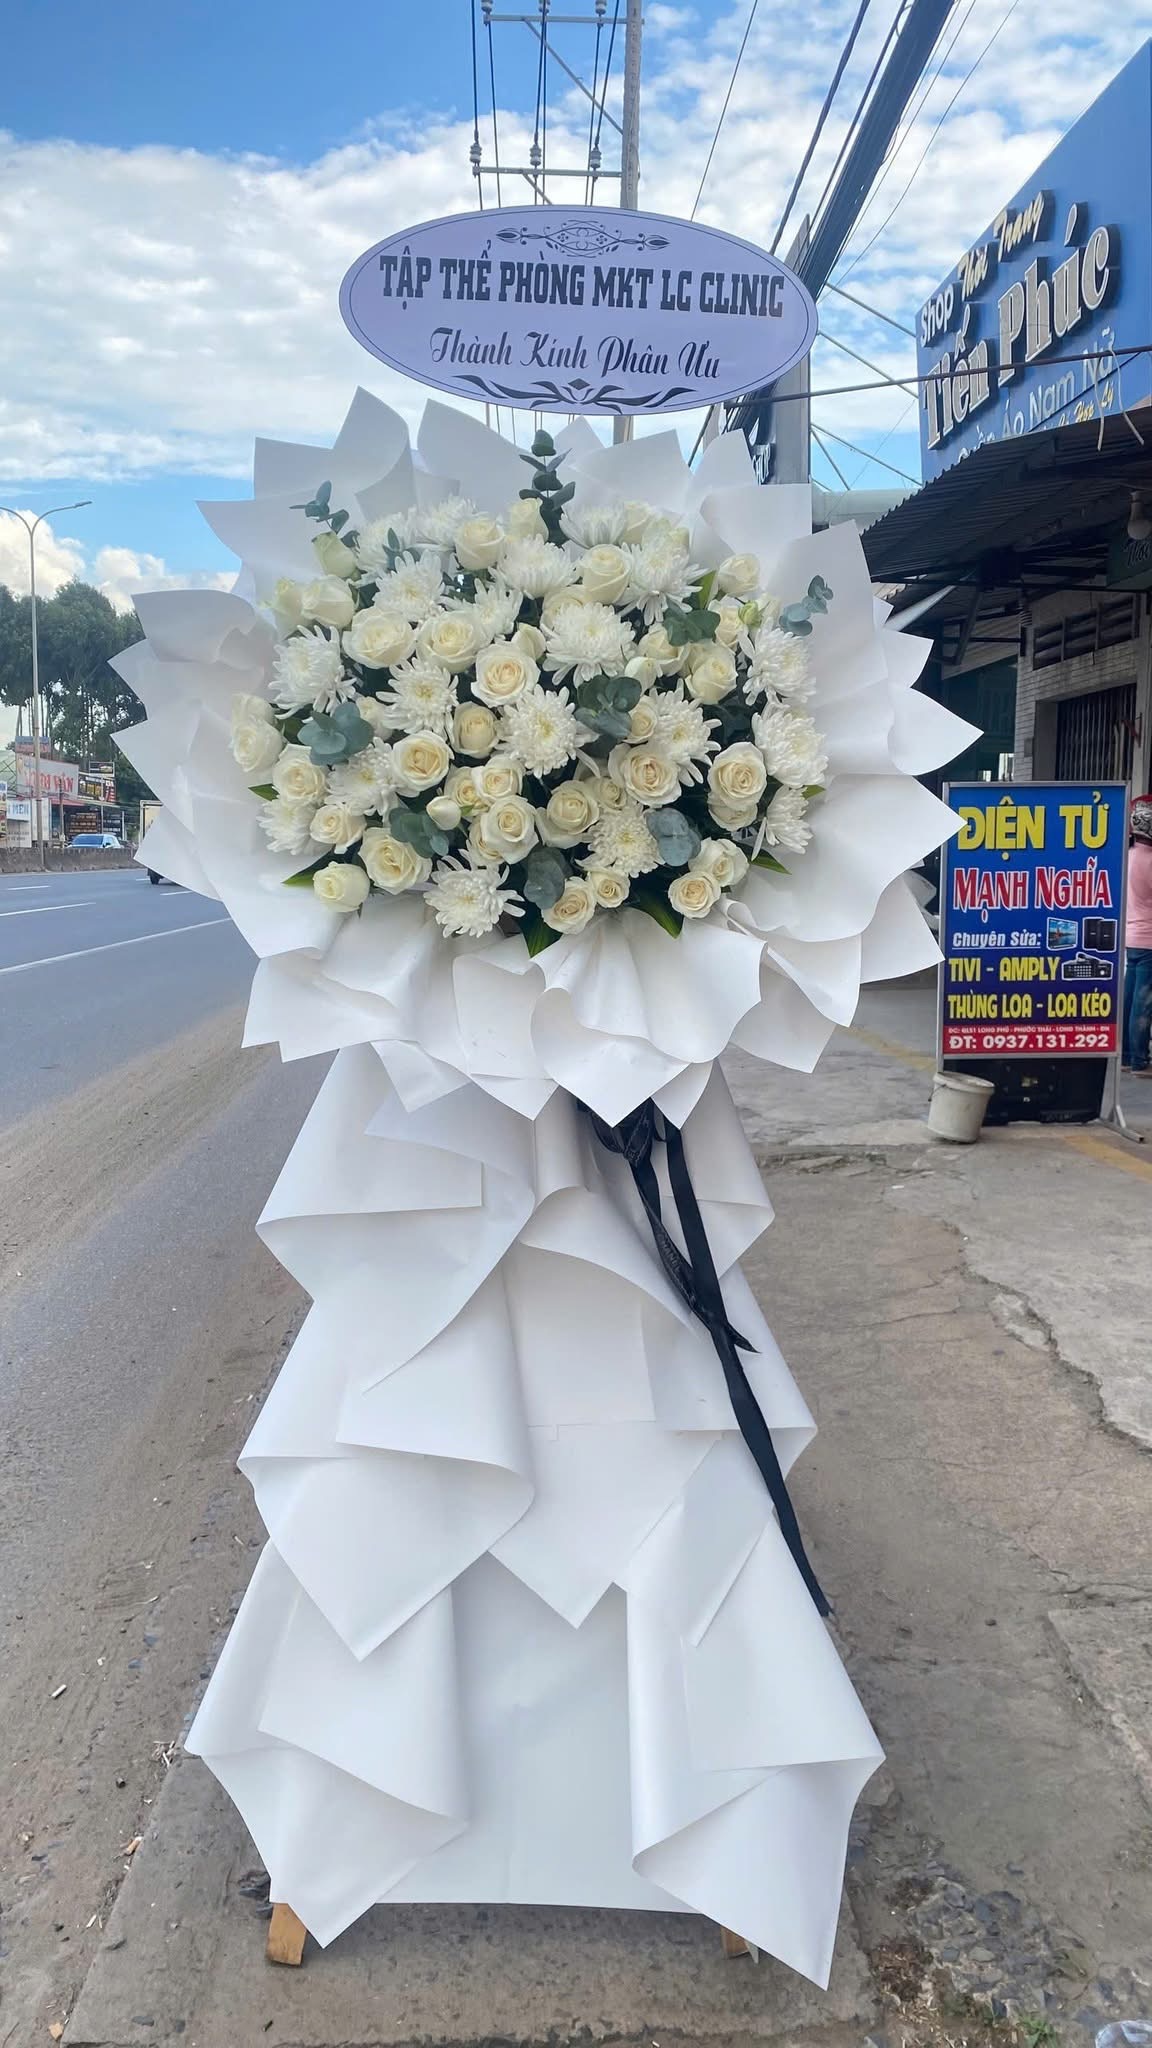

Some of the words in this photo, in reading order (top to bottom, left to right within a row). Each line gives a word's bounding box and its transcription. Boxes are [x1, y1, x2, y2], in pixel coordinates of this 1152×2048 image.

[380, 245, 432, 310] TẬP
[440, 240, 492, 301] THỂ
[499, 251, 585, 307] PHÒNG
[592, 266, 653, 309] MKT
[661, 269, 692, 313] LC
[700, 273, 785, 318] CLINIC
[921, 284, 953, 348] Shop
[957, 243, 988, 301] Thời
[993, 191, 1045, 262] Trang
[429, 327, 512, 366] Thành
[519, 330, 588, 369] Kính
[597, 335, 669, 378] Phân
[677, 340, 721, 378] Ưu
[923, 303, 989, 450] Tiến
[998, 204, 1110, 387] Phúc
[1029, 370, 1074, 426] Nam
[957, 795, 1046, 860] ĐIỆN
[953, 867, 1029, 923] MẠNH
[1035, 856, 1112, 912] NGHĨA
[952, 931, 1006, 949] Chuyên
[1010, 928, 1041, 947] Sửa:
[948, 957, 981, 982] TIVI
[999, 956, 1061, 982] AMPLY
[948, 989, 998, 1019] THÙNG
[1002, 993, 1033, 1018] LOA
[1047, 993, 1078, 1018] LOA
[1081, 988, 1111, 1018] KÉO
[949, 1036, 977, 1049] ĐT:
[982, 1034, 1109, 1049] 0937.131.292
